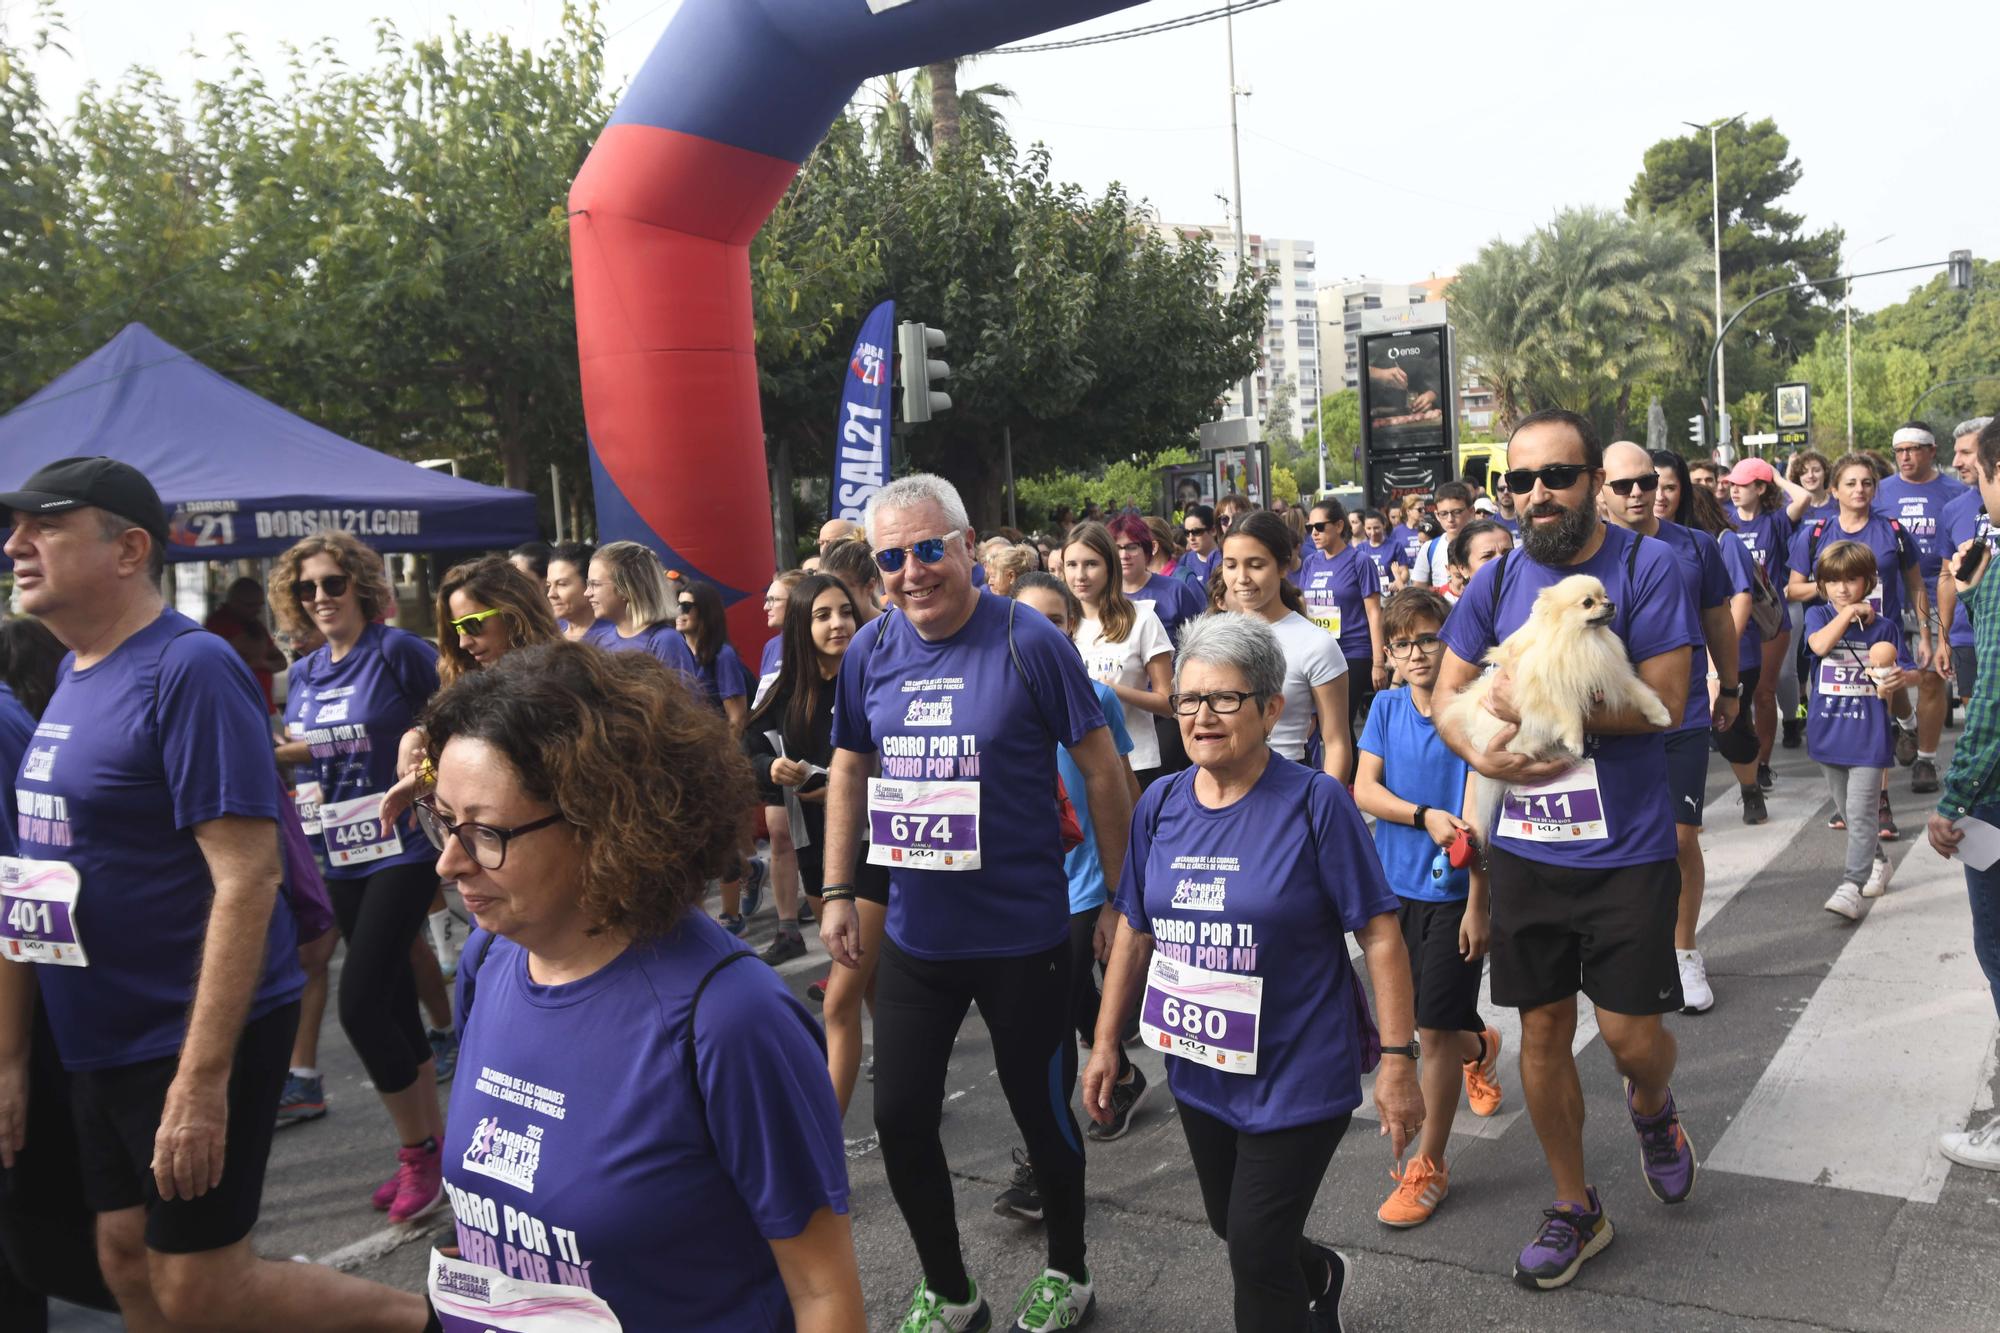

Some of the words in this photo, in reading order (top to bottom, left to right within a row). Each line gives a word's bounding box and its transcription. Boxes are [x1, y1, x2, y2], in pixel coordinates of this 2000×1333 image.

[1400, 347, 1420, 356] enso
[863, 355, 880, 387] 21
[185, 500, 238, 513] DORSAL
[192, 513, 235, 547] 21
[255, 510, 419, 538] DORSAL21.COM
[1834, 667, 1869, 682] 574
[940, 708, 952, 716] LAS
[332, 725, 354, 741] POR
[882, 736, 925, 756] CORRO
[929, 735, 958, 757] POR
[962, 735, 975, 756] TI
[926, 757, 954, 778] POR
[958, 751, 981, 777] MÍ
[34, 793, 55, 820] POR
[53, 796, 68, 821] TI
[1515, 793, 1572, 818] 711
[335, 821, 376, 845] 449
[890, 814, 953, 843] 674
[1191, 883, 1225, 891] CARRERA
[1200, 891, 1210, 899] DE
[1211, 891, 1226, 899] LAS
[1186, 897, 1223, 906] CIUDADES
[7, 900, 52, 934] 401
[1152, 917, 1196, 944] CORRO
[1200, 922, 1232, 946] POR
[1236, 923, 1253, 947] TI
[1195, 945, 1228, 970] POR
[1232, 943, 1259, 971] MÍ
[1162, 997, 1227, 1040] 680
[1179, 1039, 1206, 1052] KIA
[492, 1085, 500, 1098] EL
[500, 1088, 525, 1106] CÁNCER
[524, 1095, 534, 1109] DE
[533, 1098, 566, 1120] PÁNCREAS
[512, 1078, 522, 1090] DE
[521, 1081, 534, 1095] LAS
[534, 1085, 565, 1106] CIUDADES
[493, 1127, 541, 1157] CARRERA
[526, 1124, 544, 1141] 2022
[484, 1154, 534, 1183] CIUDADES
[504, 1145, 519, 1163] DE
[520, 1151, 540, 1171] LAS
[503, 1204, 552, 1257] POR
[551, 1226, 582, 1266] TI
[449, 1271, 479, 1284] CARRERA
[480, 1277, 489, 1287] DE
[503, 1243, 551, 1285] POR
[555, 1260, 593, 1293] MÍ
[459, 1281, 490, 1298] CIUDADES
